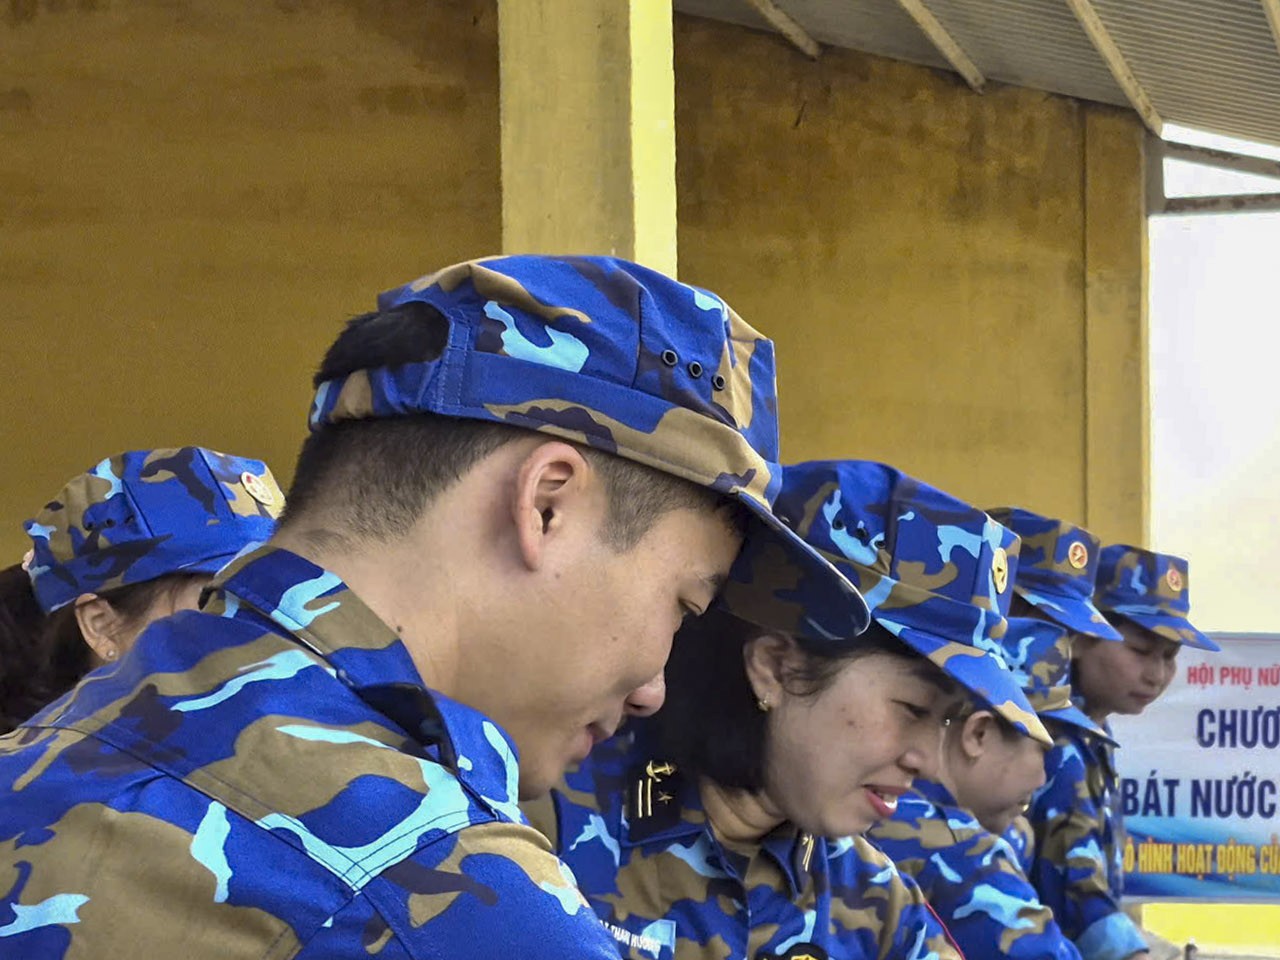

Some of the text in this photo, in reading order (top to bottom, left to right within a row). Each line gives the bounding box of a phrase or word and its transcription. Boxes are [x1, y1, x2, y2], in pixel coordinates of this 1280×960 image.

[1187, 662, 1214, 689] HỘI
[1220, 666, 1252, 690] PHỤ
[1121, 769, 1180, 817] BÁT
[1190, 771, 1276, 819] NƯỚC
[1138, 836, 1173, 873] HÌNH
[1176, 844, 1213, 880] HOẠT
[1217, 837, 1257, 881] ĐỘNG
